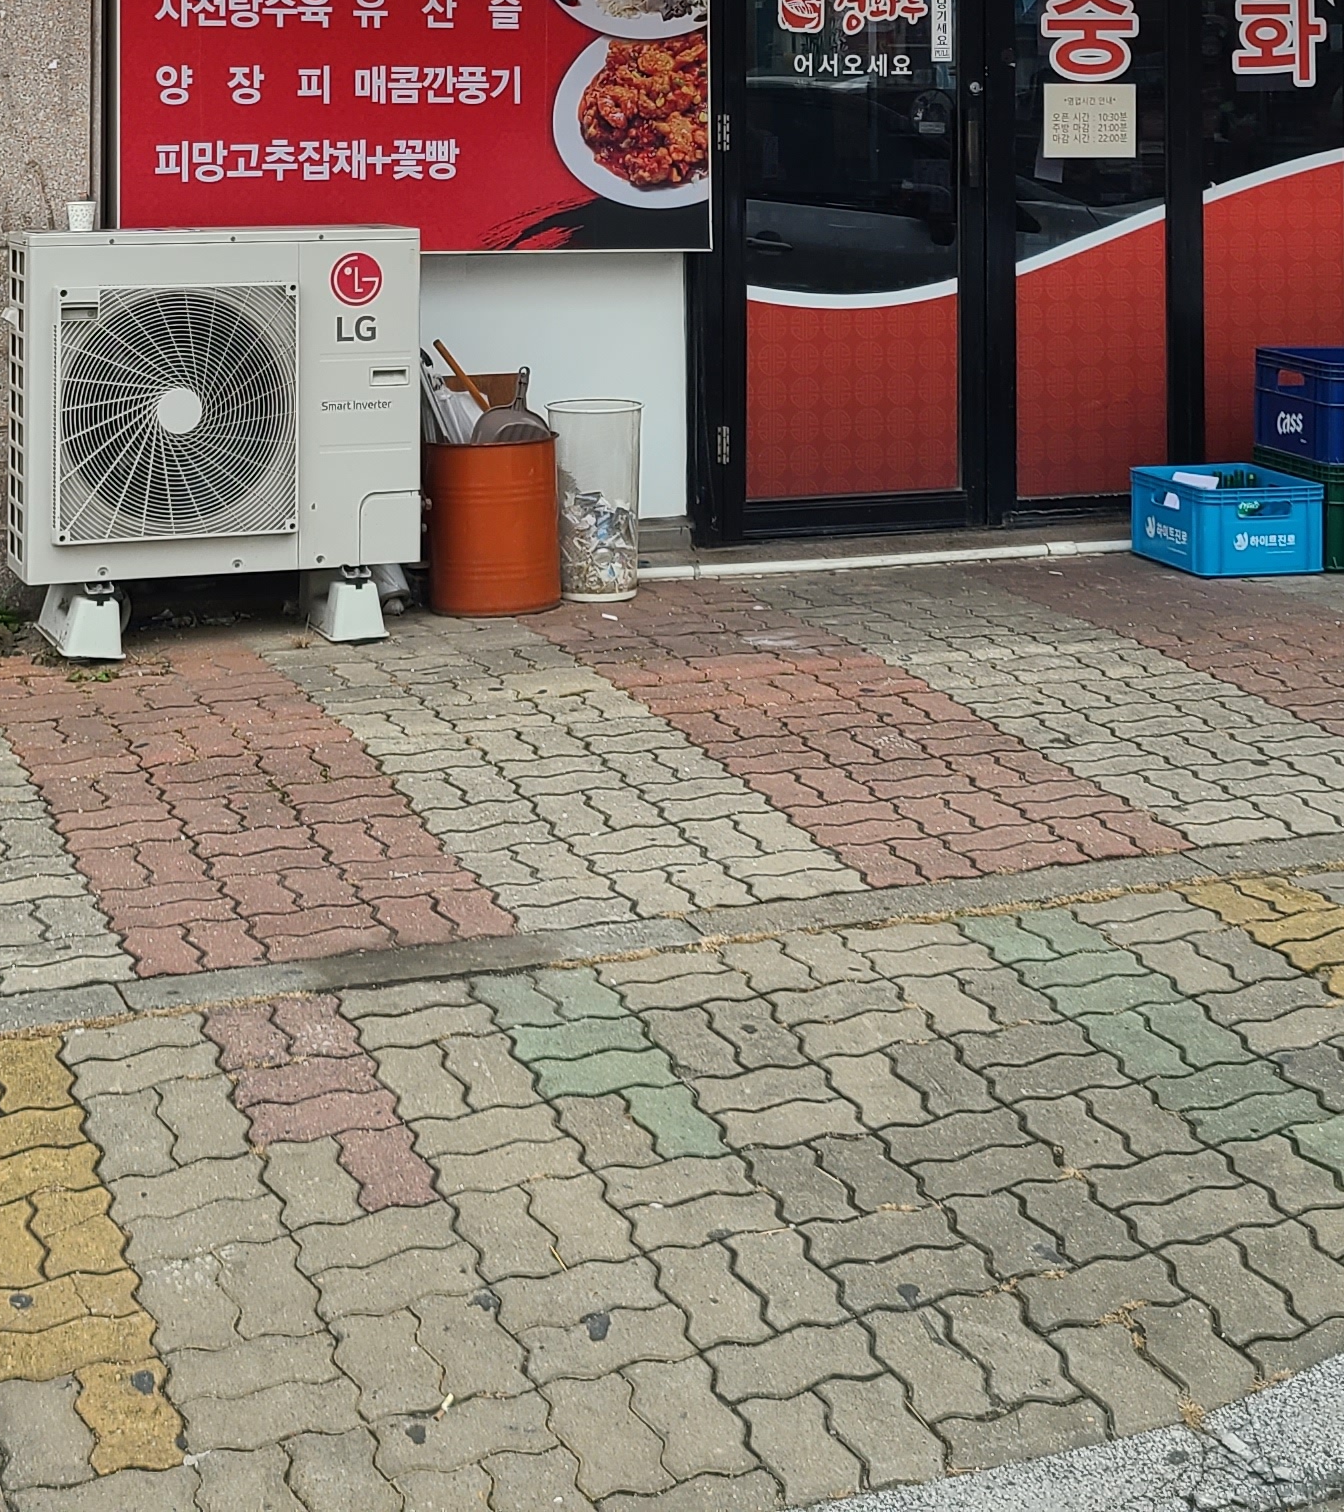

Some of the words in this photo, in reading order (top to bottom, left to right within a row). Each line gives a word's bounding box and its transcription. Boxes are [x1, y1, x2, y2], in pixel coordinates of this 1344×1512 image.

[793, 53, 913, 78] 어서오세요
[354, 65, 524, 106] 매콤깐풍기
[1052, 112, 1069, 123] 오픈
[1073, 112, 1090, 123] 시간
[1098, 112, 1128, 122] 10:30분
[1052, 123, 1069, 133] 주방
[1073, 123, 1090, 133] 마감
[1098, 123, 1128, 133] 21:00분
[1052, 134, 1069, 144] 마감
[1073, 134, 1090, 144] 시간
[1098, 133, 1128, 143] 22:00분
[155, 138, 461, 182] 피망고추잡채+꽃빵
[336, 315, 376, 343] LG
[321, 399, 350, 412] Smart
[352, 398, 392, 412] Inverter
[1156, 522, 1188, 545] 하이트진로
[1249, 532, 1295, 548] 하이트진로
